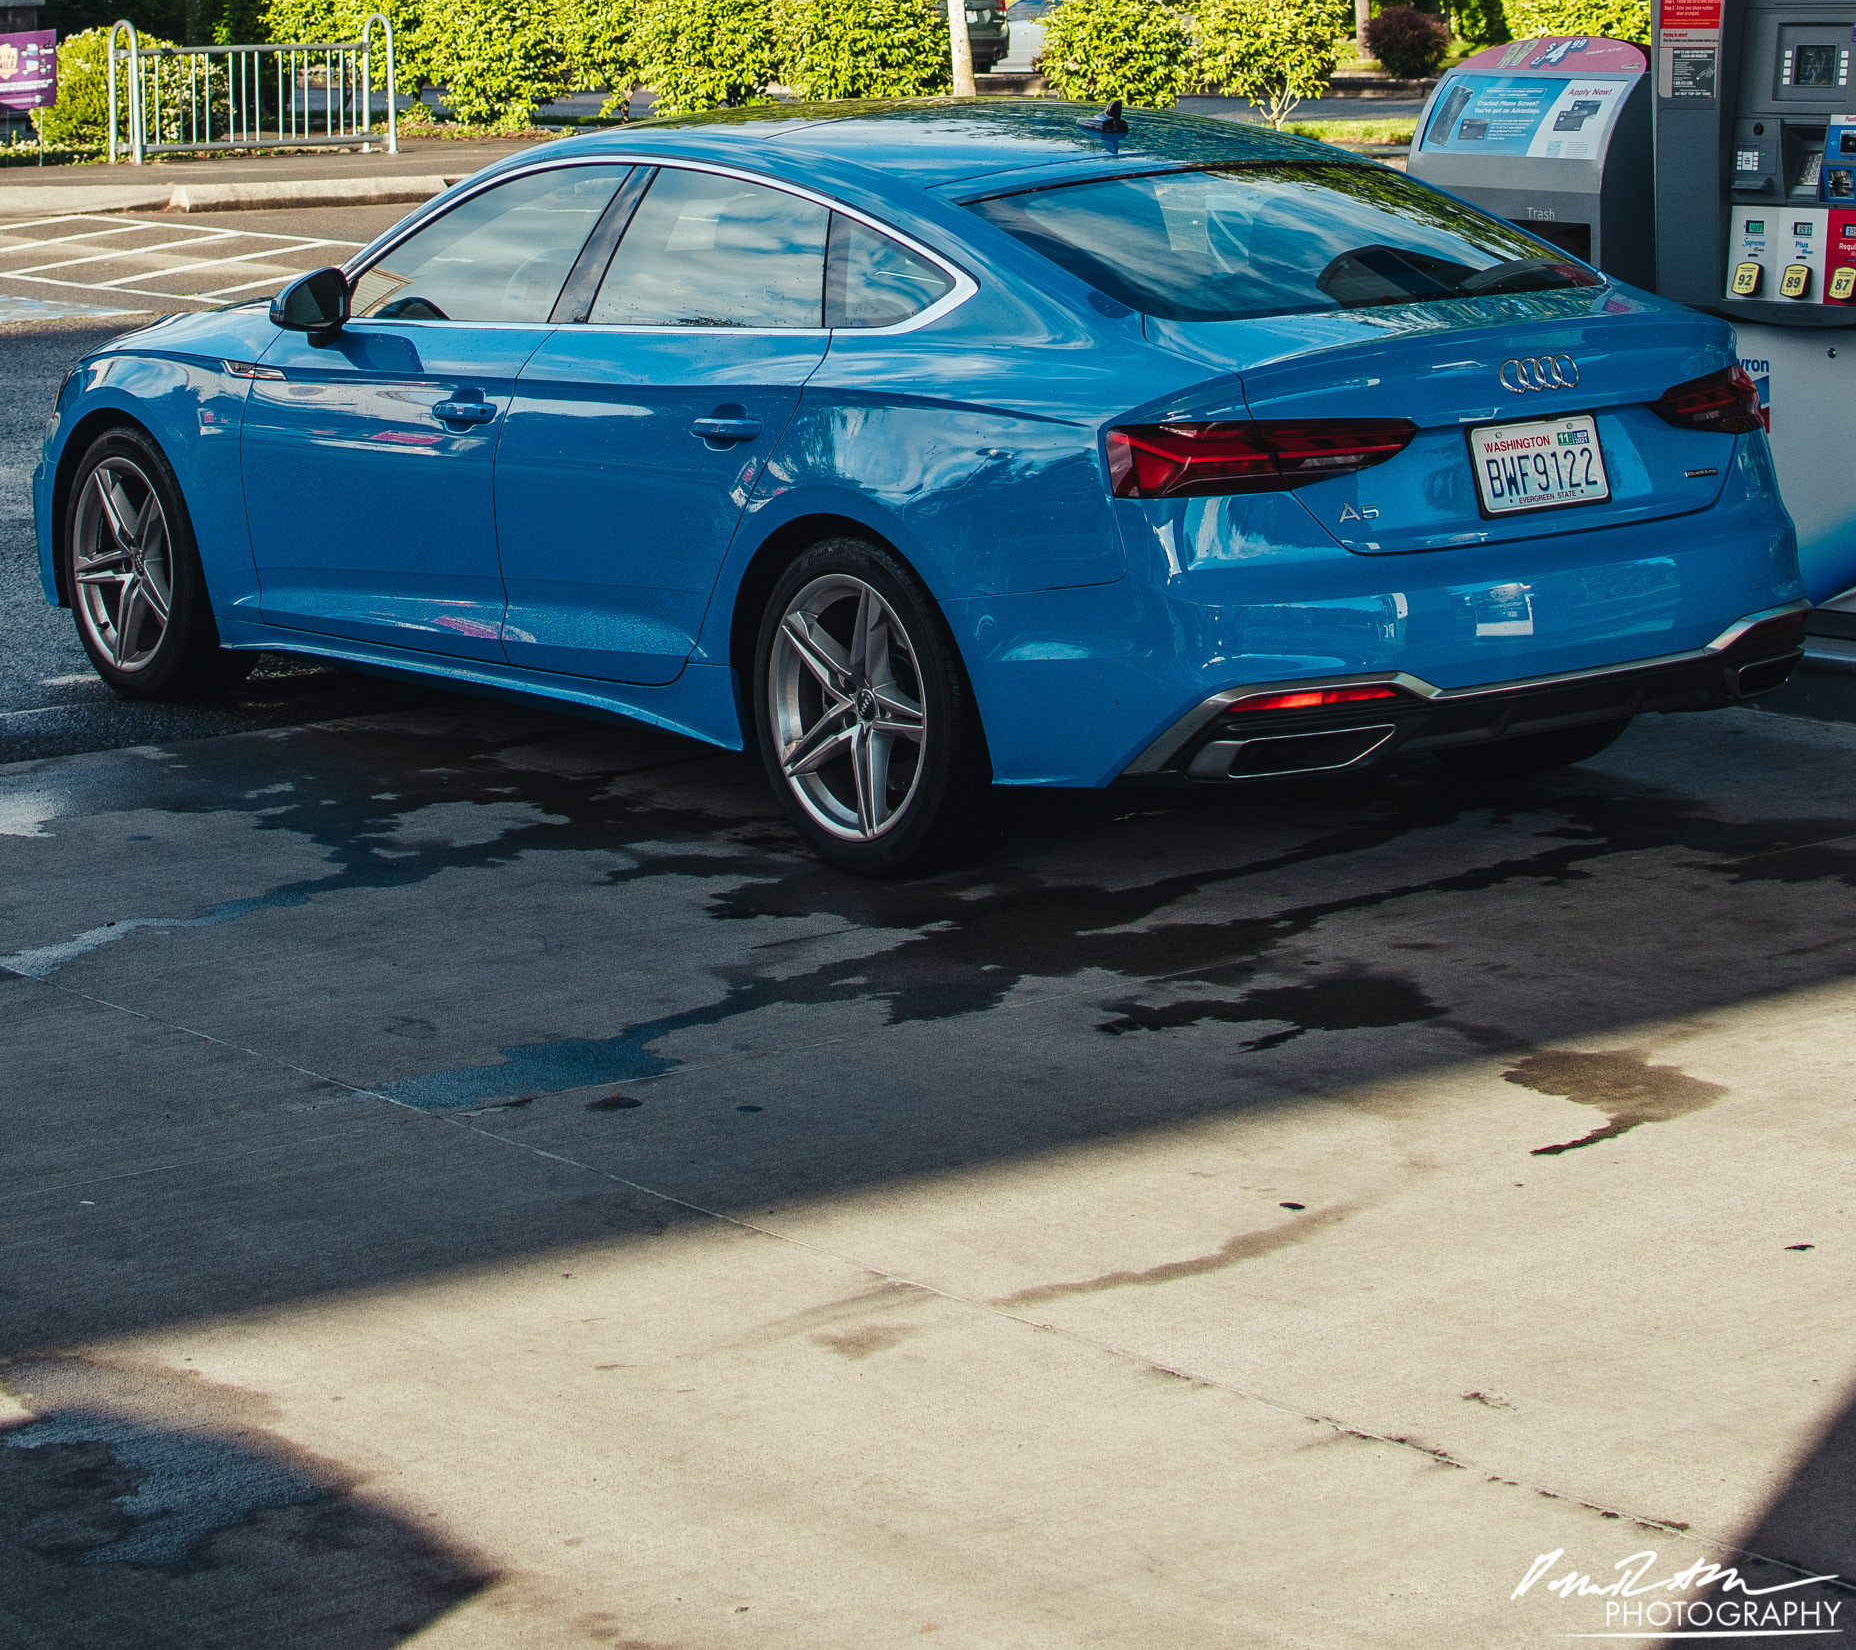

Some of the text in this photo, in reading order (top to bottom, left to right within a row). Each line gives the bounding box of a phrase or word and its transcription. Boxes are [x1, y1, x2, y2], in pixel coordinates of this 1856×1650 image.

[1568, 89, 1591, 97] Apply
[1527, 207, 1555, 221] Trash
[1742, 237, 1766, 247] Supreme
[1738, 274, 1752, 286] 92
[1786, 276, 1801, 288] 89
[1835, 278, 1851, 291] 87
[1737, 357, 1770, 373] vron
[1484, 435, 1551, 453] WASHINGTON
[1559, 432, 1570, 444] 11
[1486, 447, 1598, 498] BWF9122
[1687, 469, 1718, 477] quattro
[1518, 489, 1577, 504] EVERGREEN STATE
[1339, 502, 1380, 523] A5
[808, 550, 854, 567] Continental
